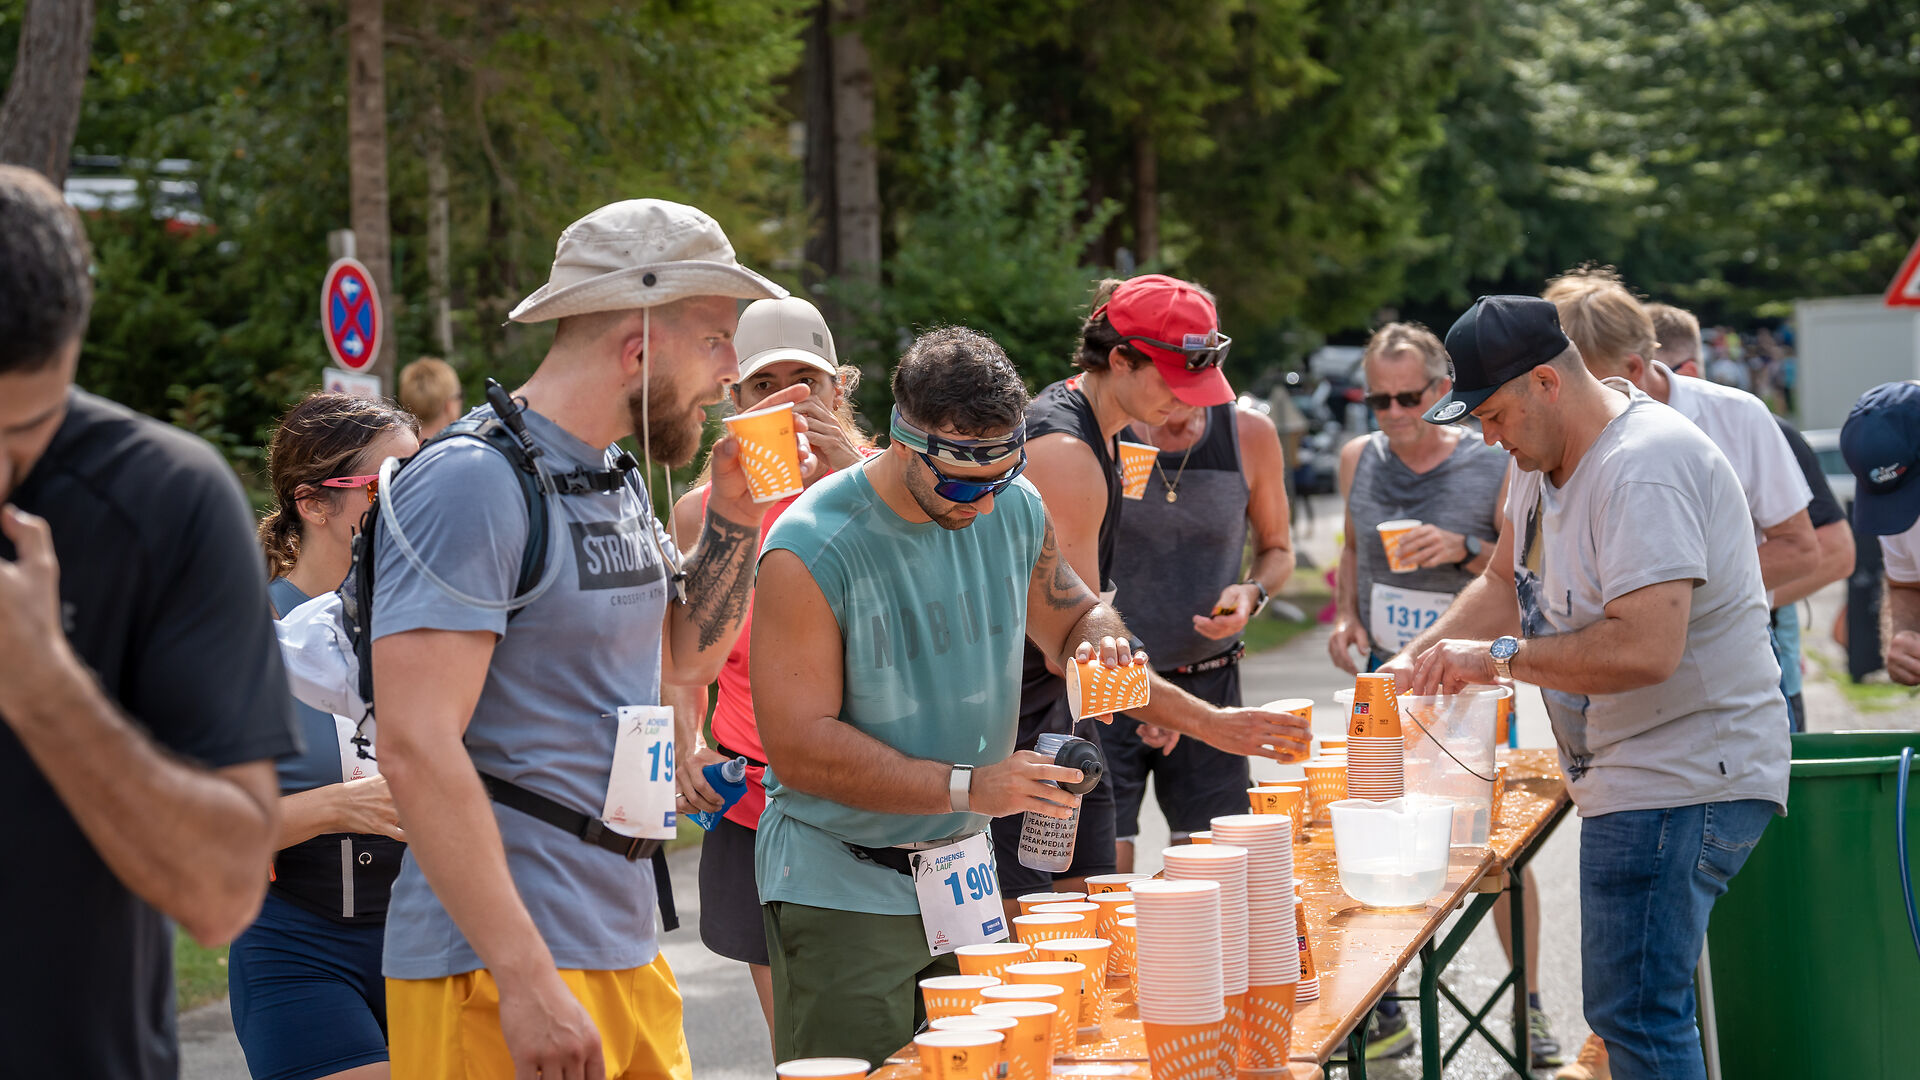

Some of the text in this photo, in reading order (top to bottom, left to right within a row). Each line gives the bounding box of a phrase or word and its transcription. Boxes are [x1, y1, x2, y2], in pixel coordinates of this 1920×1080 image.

[1386, 603, 1439, 629] 1312
[647, 741, 673, 782] 19
[936, 861, 953, 872] LAUF
